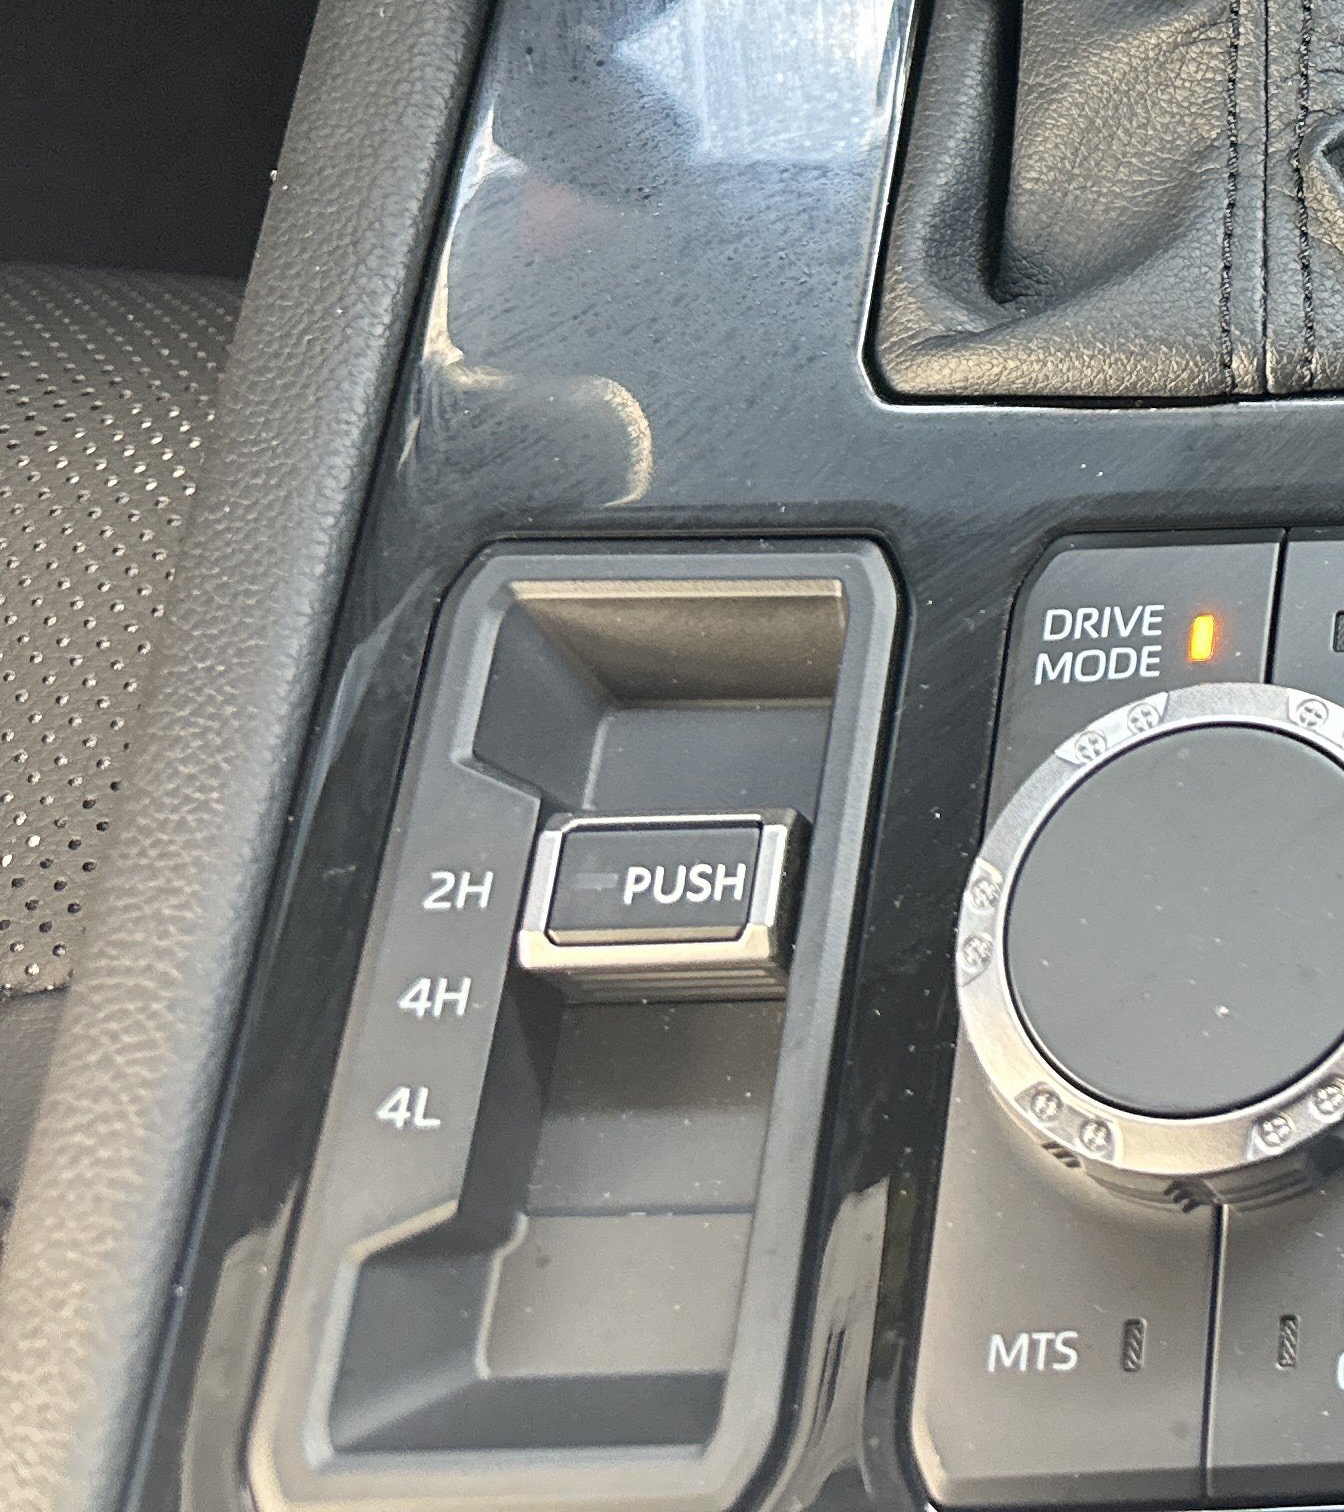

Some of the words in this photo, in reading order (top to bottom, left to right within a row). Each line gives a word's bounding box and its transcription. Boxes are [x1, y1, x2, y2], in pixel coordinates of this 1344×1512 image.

[1043, 605, 1164, 641] DRIVE
[1034, 644, 1162, 685] MODE
[422, 870, 494, 911] 2H
[622, 862, 747, 906] PUSH
[399, 976, 471, 1018] 4H
[376, 1087, 441, 1129] 4L
[987, 1330, 1079, 1373] MTS
